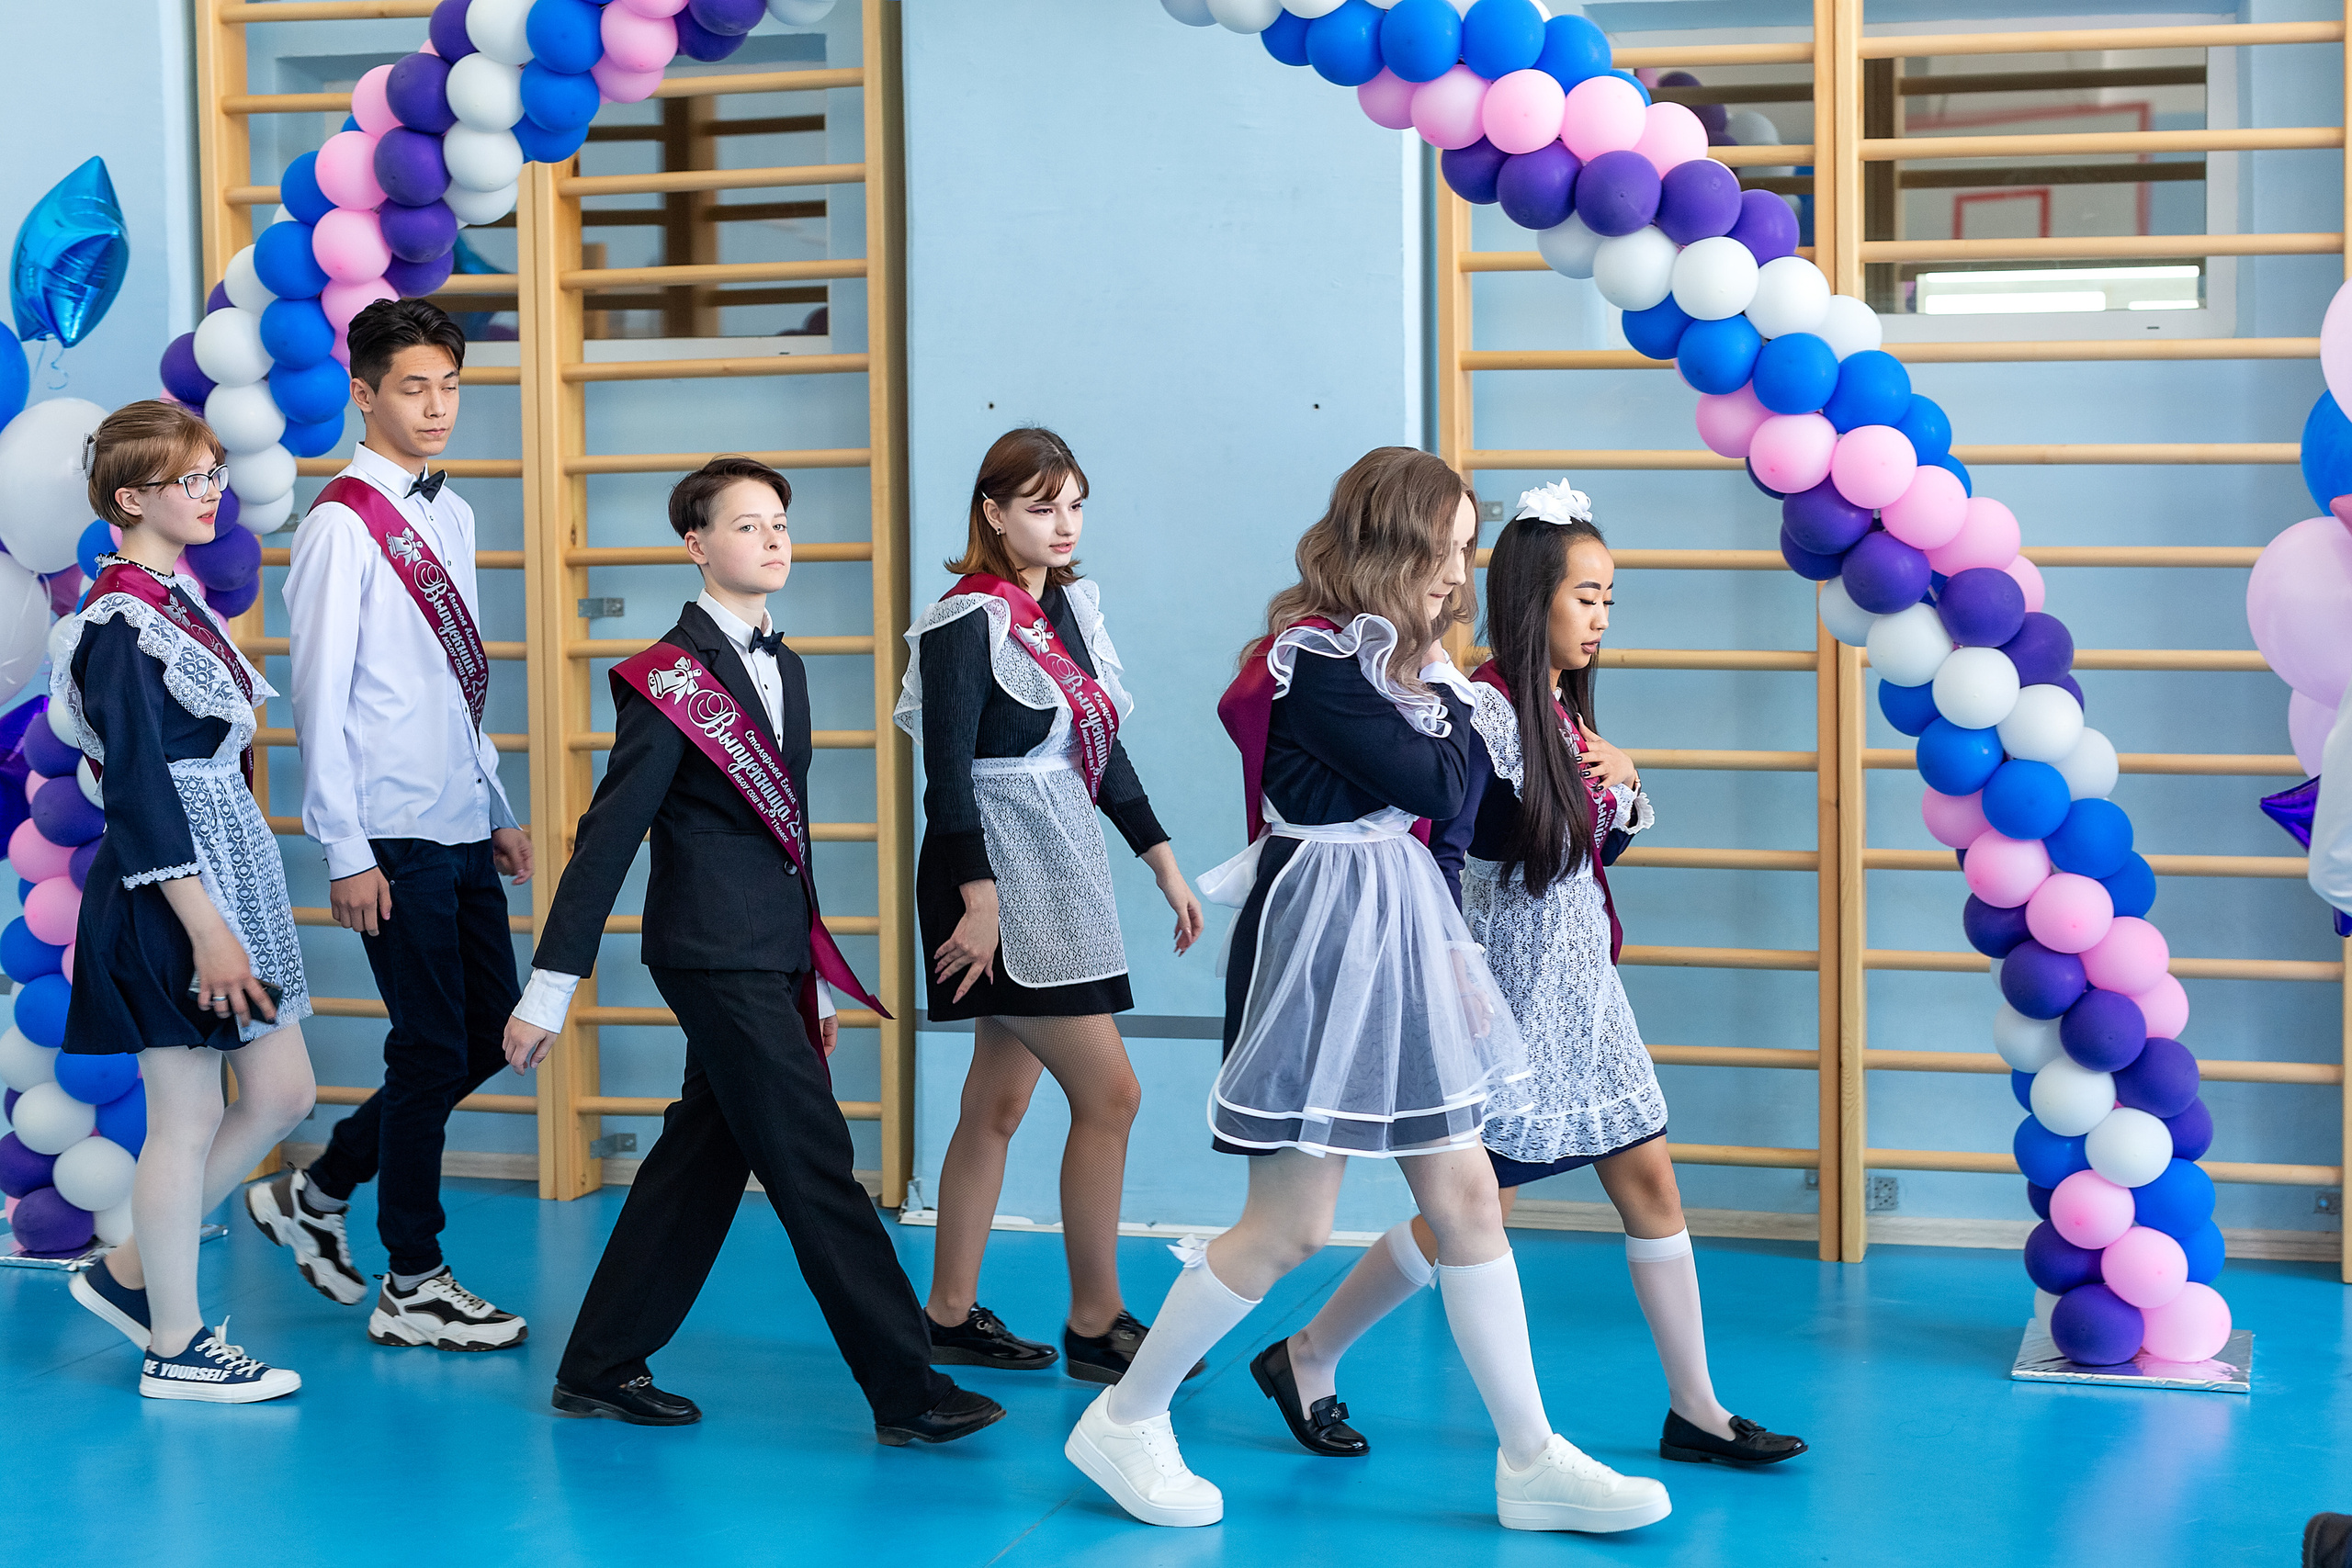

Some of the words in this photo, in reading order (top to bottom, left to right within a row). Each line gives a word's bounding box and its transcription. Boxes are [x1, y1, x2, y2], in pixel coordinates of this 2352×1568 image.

[413, 559, 478, 678] Выпускник
[447, 592, 468, 626] Азатов
[464, 627, 485, 671] Алмазбек
[441, 636, 458, 657] МБОУ
[454, 658, 466, 676] СОШ
[1091, 691, 1115, 730] Клецова
[687, 689, 790, 823] Выпускница
[744, 729, 784, 780] Столярова
[780, 777, 797, 806] Елена
[732, 773, 752, 790] МБОУ
[746, 788, 761, 804] СОШ
[771, 818, 790, 843] 11класс
[142, 1359, 160, 1374] BE
[159, 1362, 233, 1382] YOURSELF
